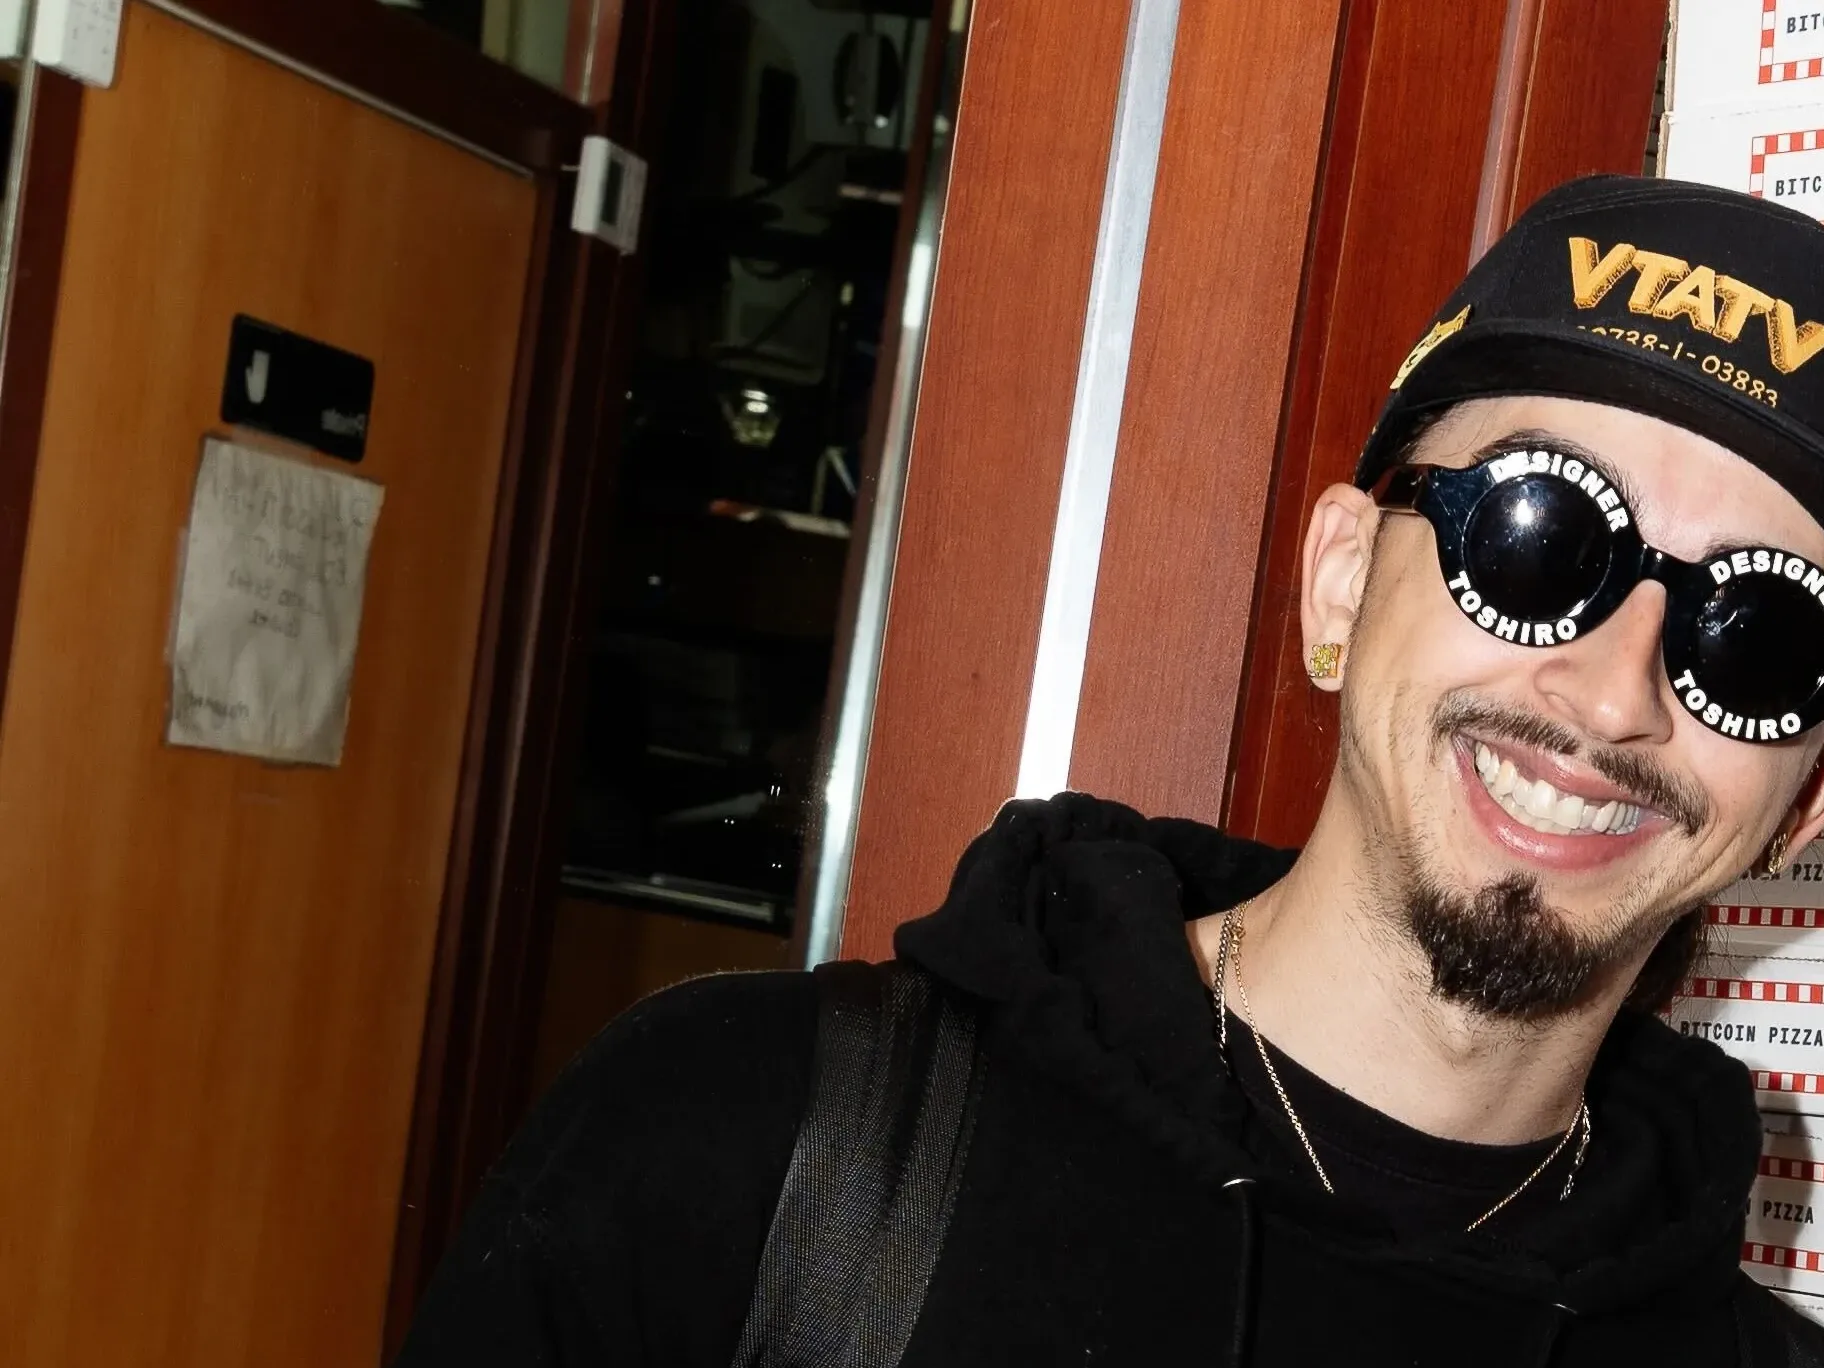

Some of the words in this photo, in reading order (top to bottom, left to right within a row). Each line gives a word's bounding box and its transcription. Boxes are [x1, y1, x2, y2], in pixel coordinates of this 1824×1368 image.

[1448, 570, 1577, 646] TOSHIRO
[1673, 669, 1801, 740] TOSHIRO
[1680, 1020, 1757, 1043] BITCOIN
[1768, 1026, 1823, 1047] PIZZA
[1762, 1199, 1814, 1224] PIZZA
